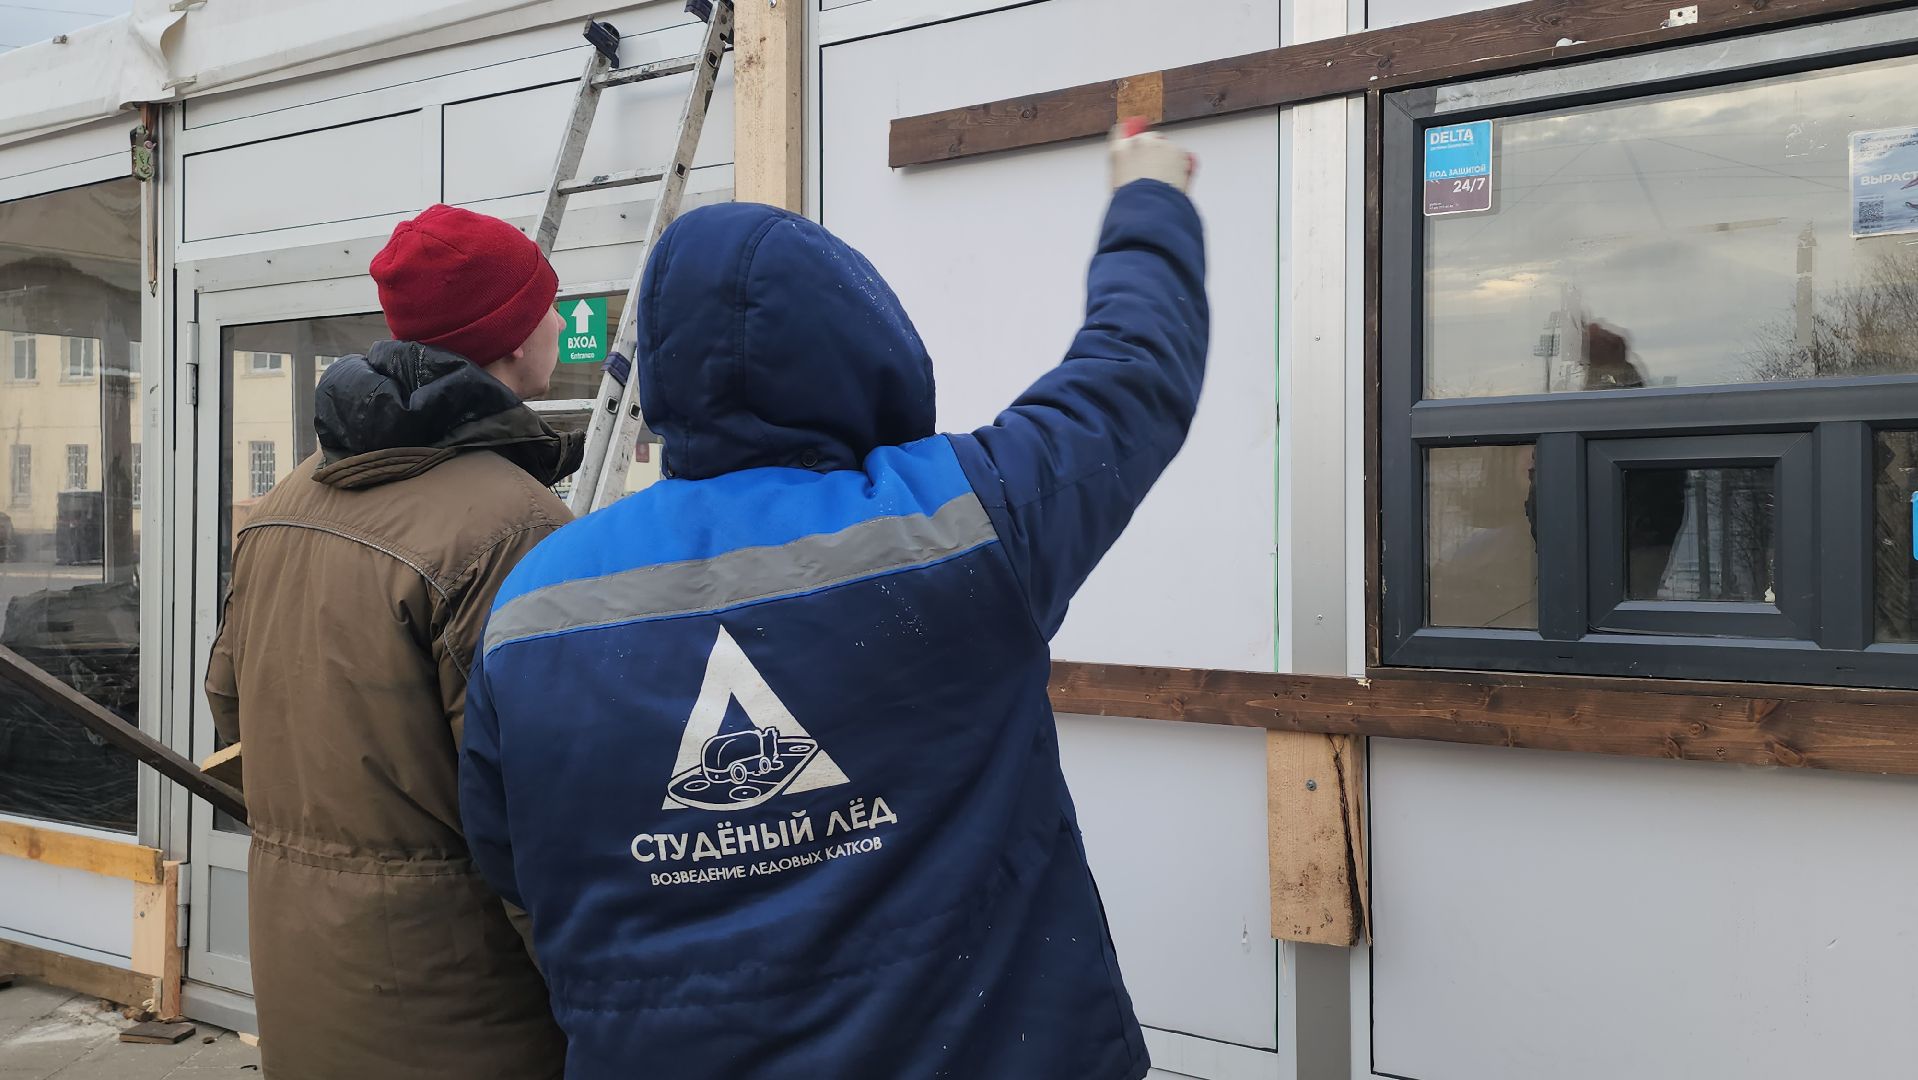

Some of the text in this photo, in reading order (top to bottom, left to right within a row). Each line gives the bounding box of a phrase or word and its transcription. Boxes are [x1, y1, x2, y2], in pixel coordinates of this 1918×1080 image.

[1430, 128, 1473, 145] DELTA
[1430, 163, 1486, 178] ПОД ЗАЩИТОЙ
[1453, 177, 1485, 193] 24/7
[567, 335, 597, 349] ВХОД
[570, 352, 595, 360] Entrance
[630, 796, 898, 863] СТУДЁНЫЙ ЛЁД
[650, 836, 883, 886] ВОЗВЕДЕНИЕ ЛЕДОВЫХ КАТКОВ
